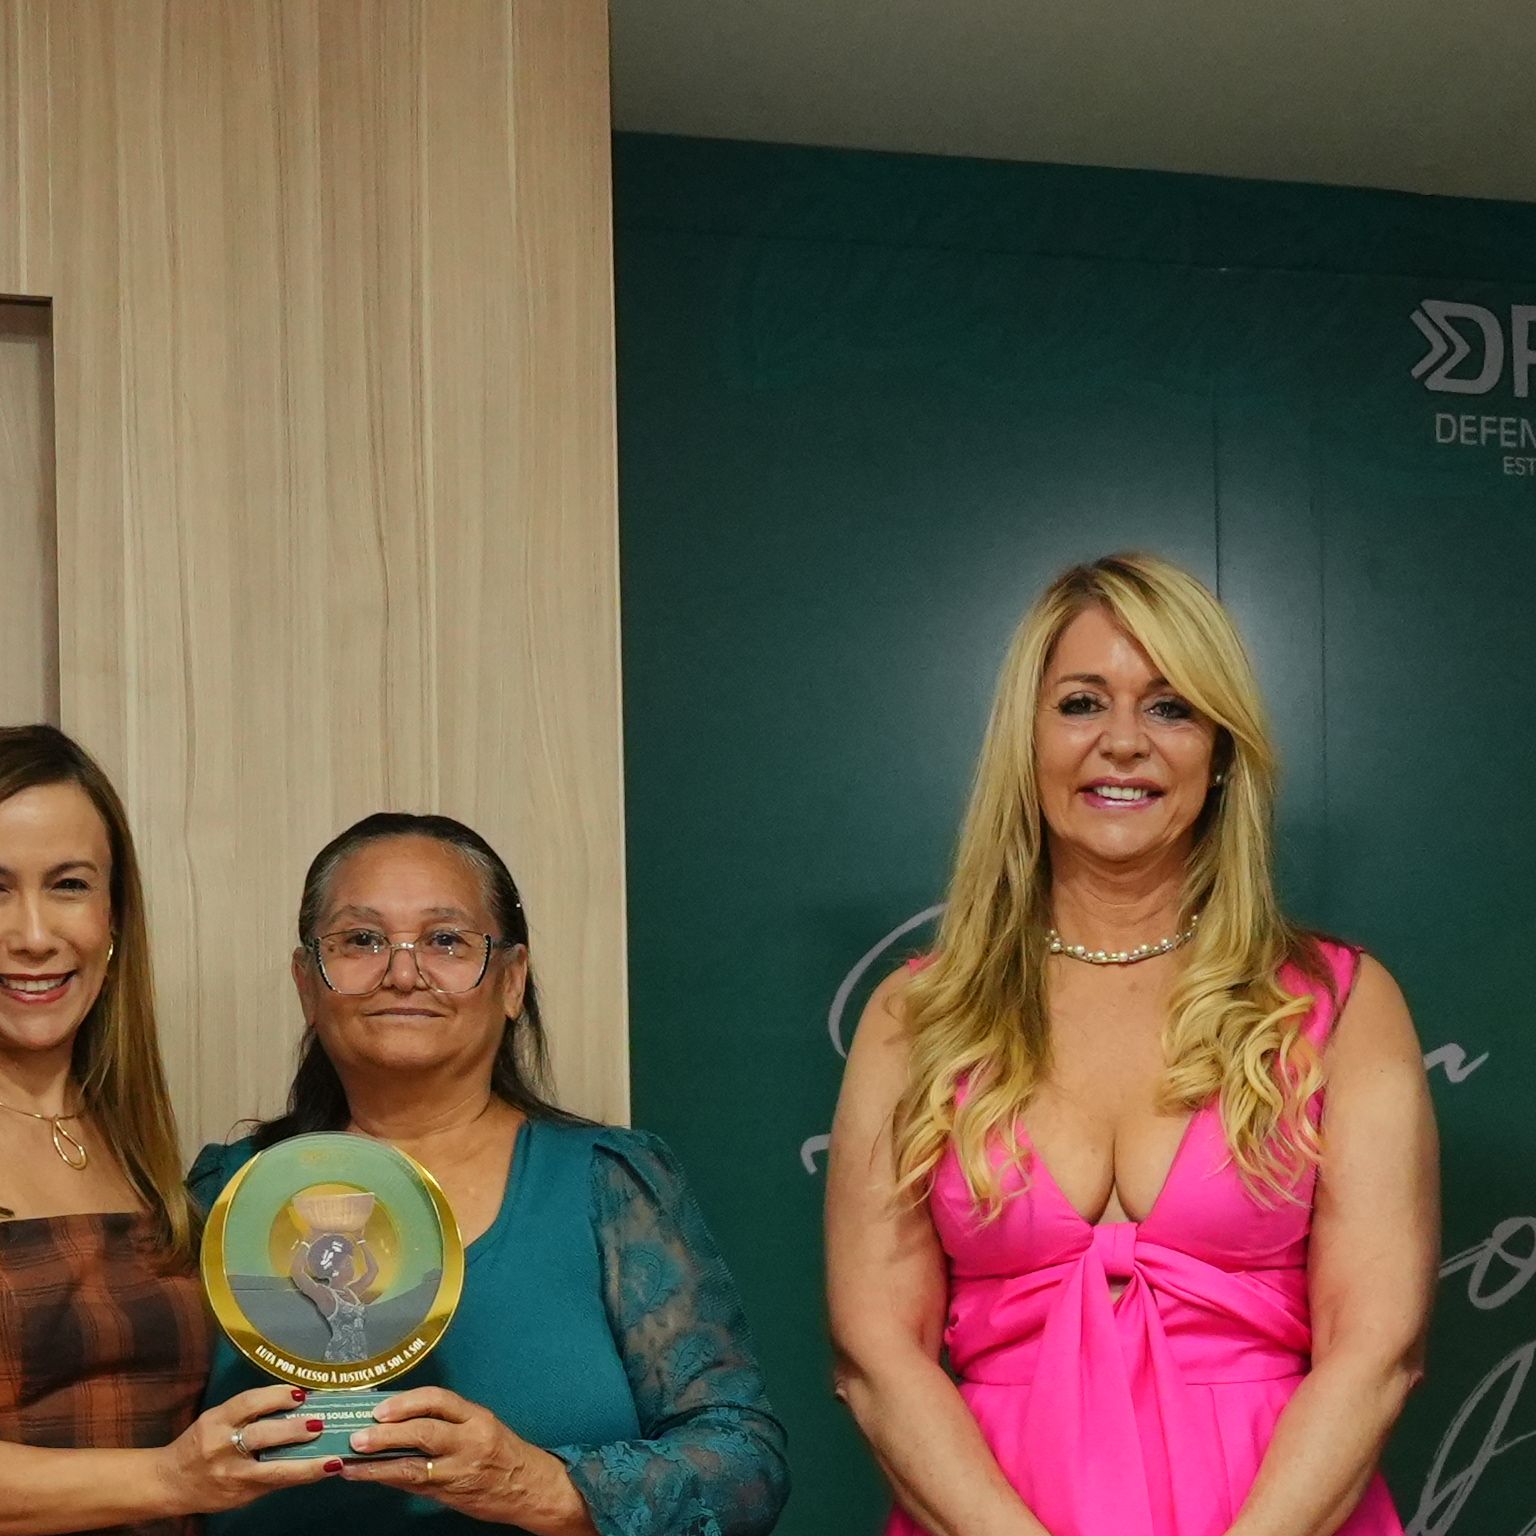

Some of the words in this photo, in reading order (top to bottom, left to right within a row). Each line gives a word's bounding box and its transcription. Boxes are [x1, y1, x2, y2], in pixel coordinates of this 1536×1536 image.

[255, 1345, 277, 1365] LUTA
[275, 1358, 296, 1374] POR
[295, 1367, 329, 1382] ACESSO
[339, 1368, 376, 1383] JUSTIÇA
[374, 1362, 388, 1376] DE
[387, 1354, 404, 1370] SOL
[403, 1349, 412, 1359] A
[408, 1337, 427, 1355] SOL
